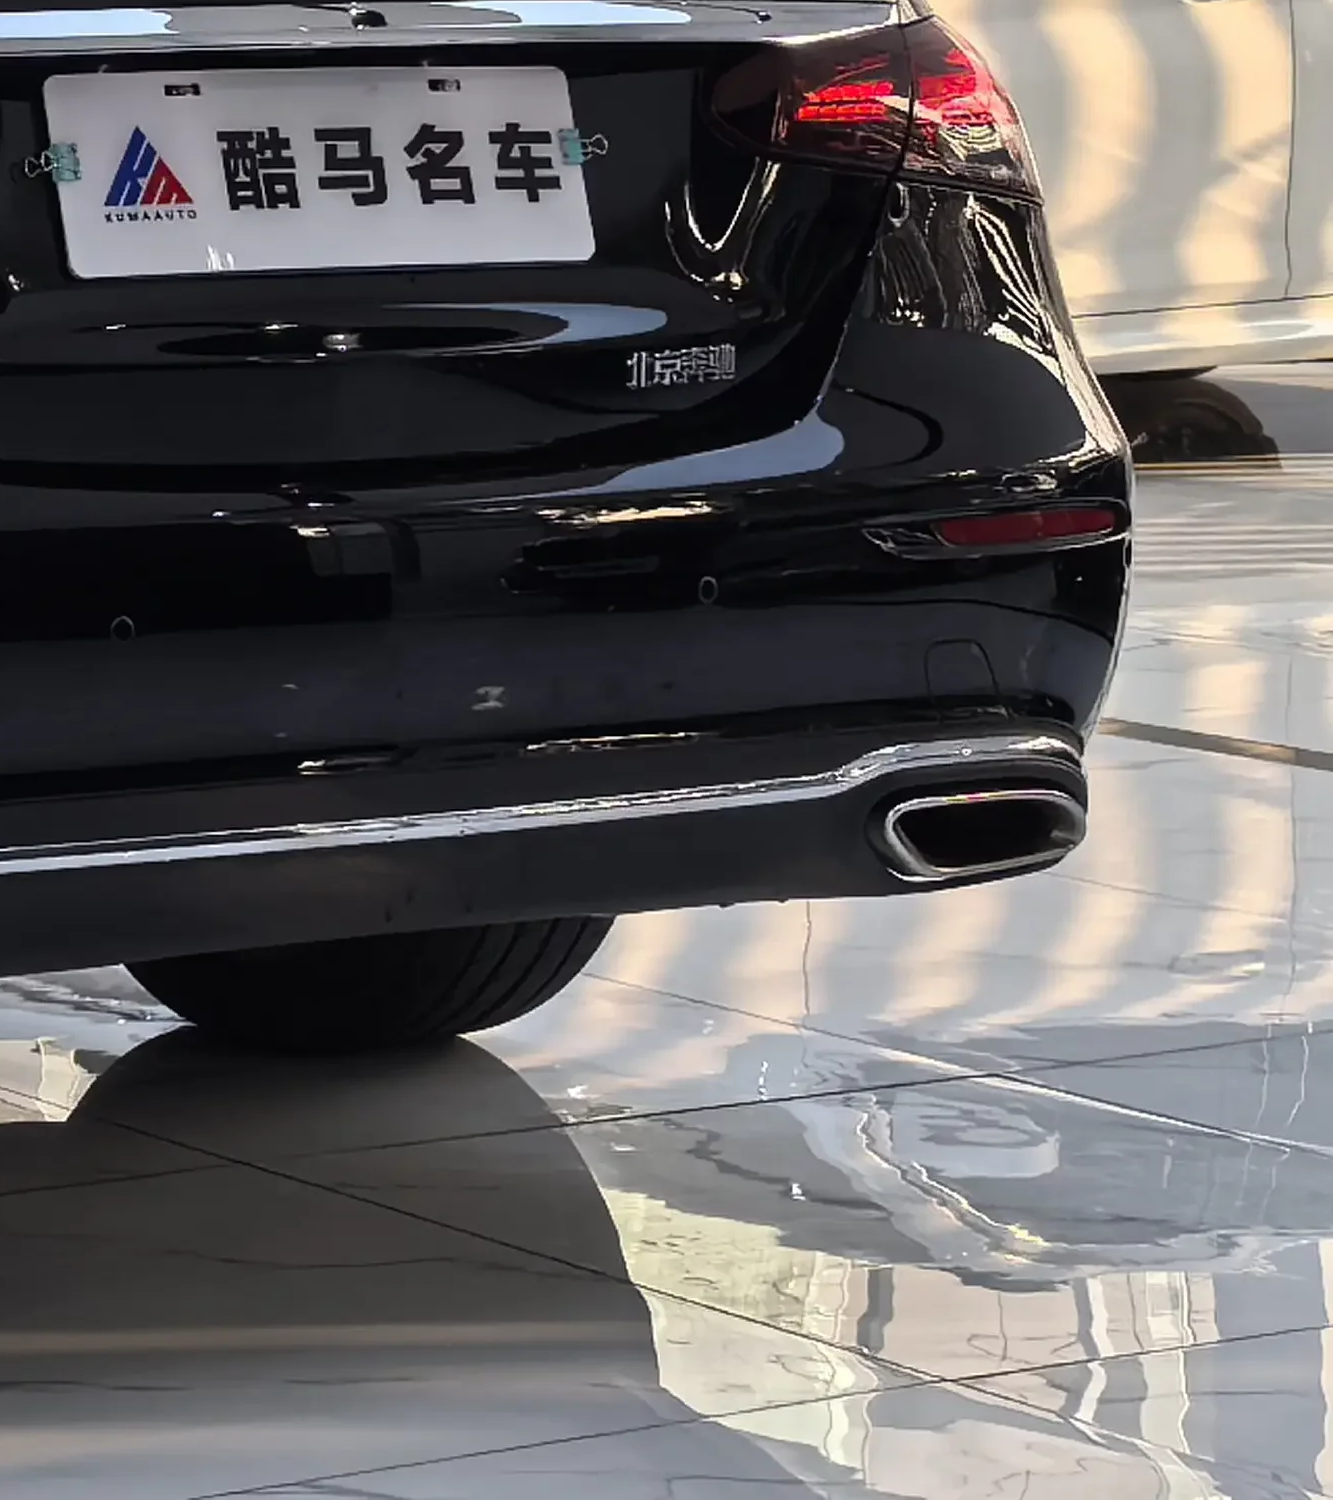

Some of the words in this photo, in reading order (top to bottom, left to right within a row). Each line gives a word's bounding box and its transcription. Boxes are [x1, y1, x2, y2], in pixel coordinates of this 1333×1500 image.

[216, 122, 562, 211] 酷马名车
[104, 209, 198, 223] KUMAAUTO
